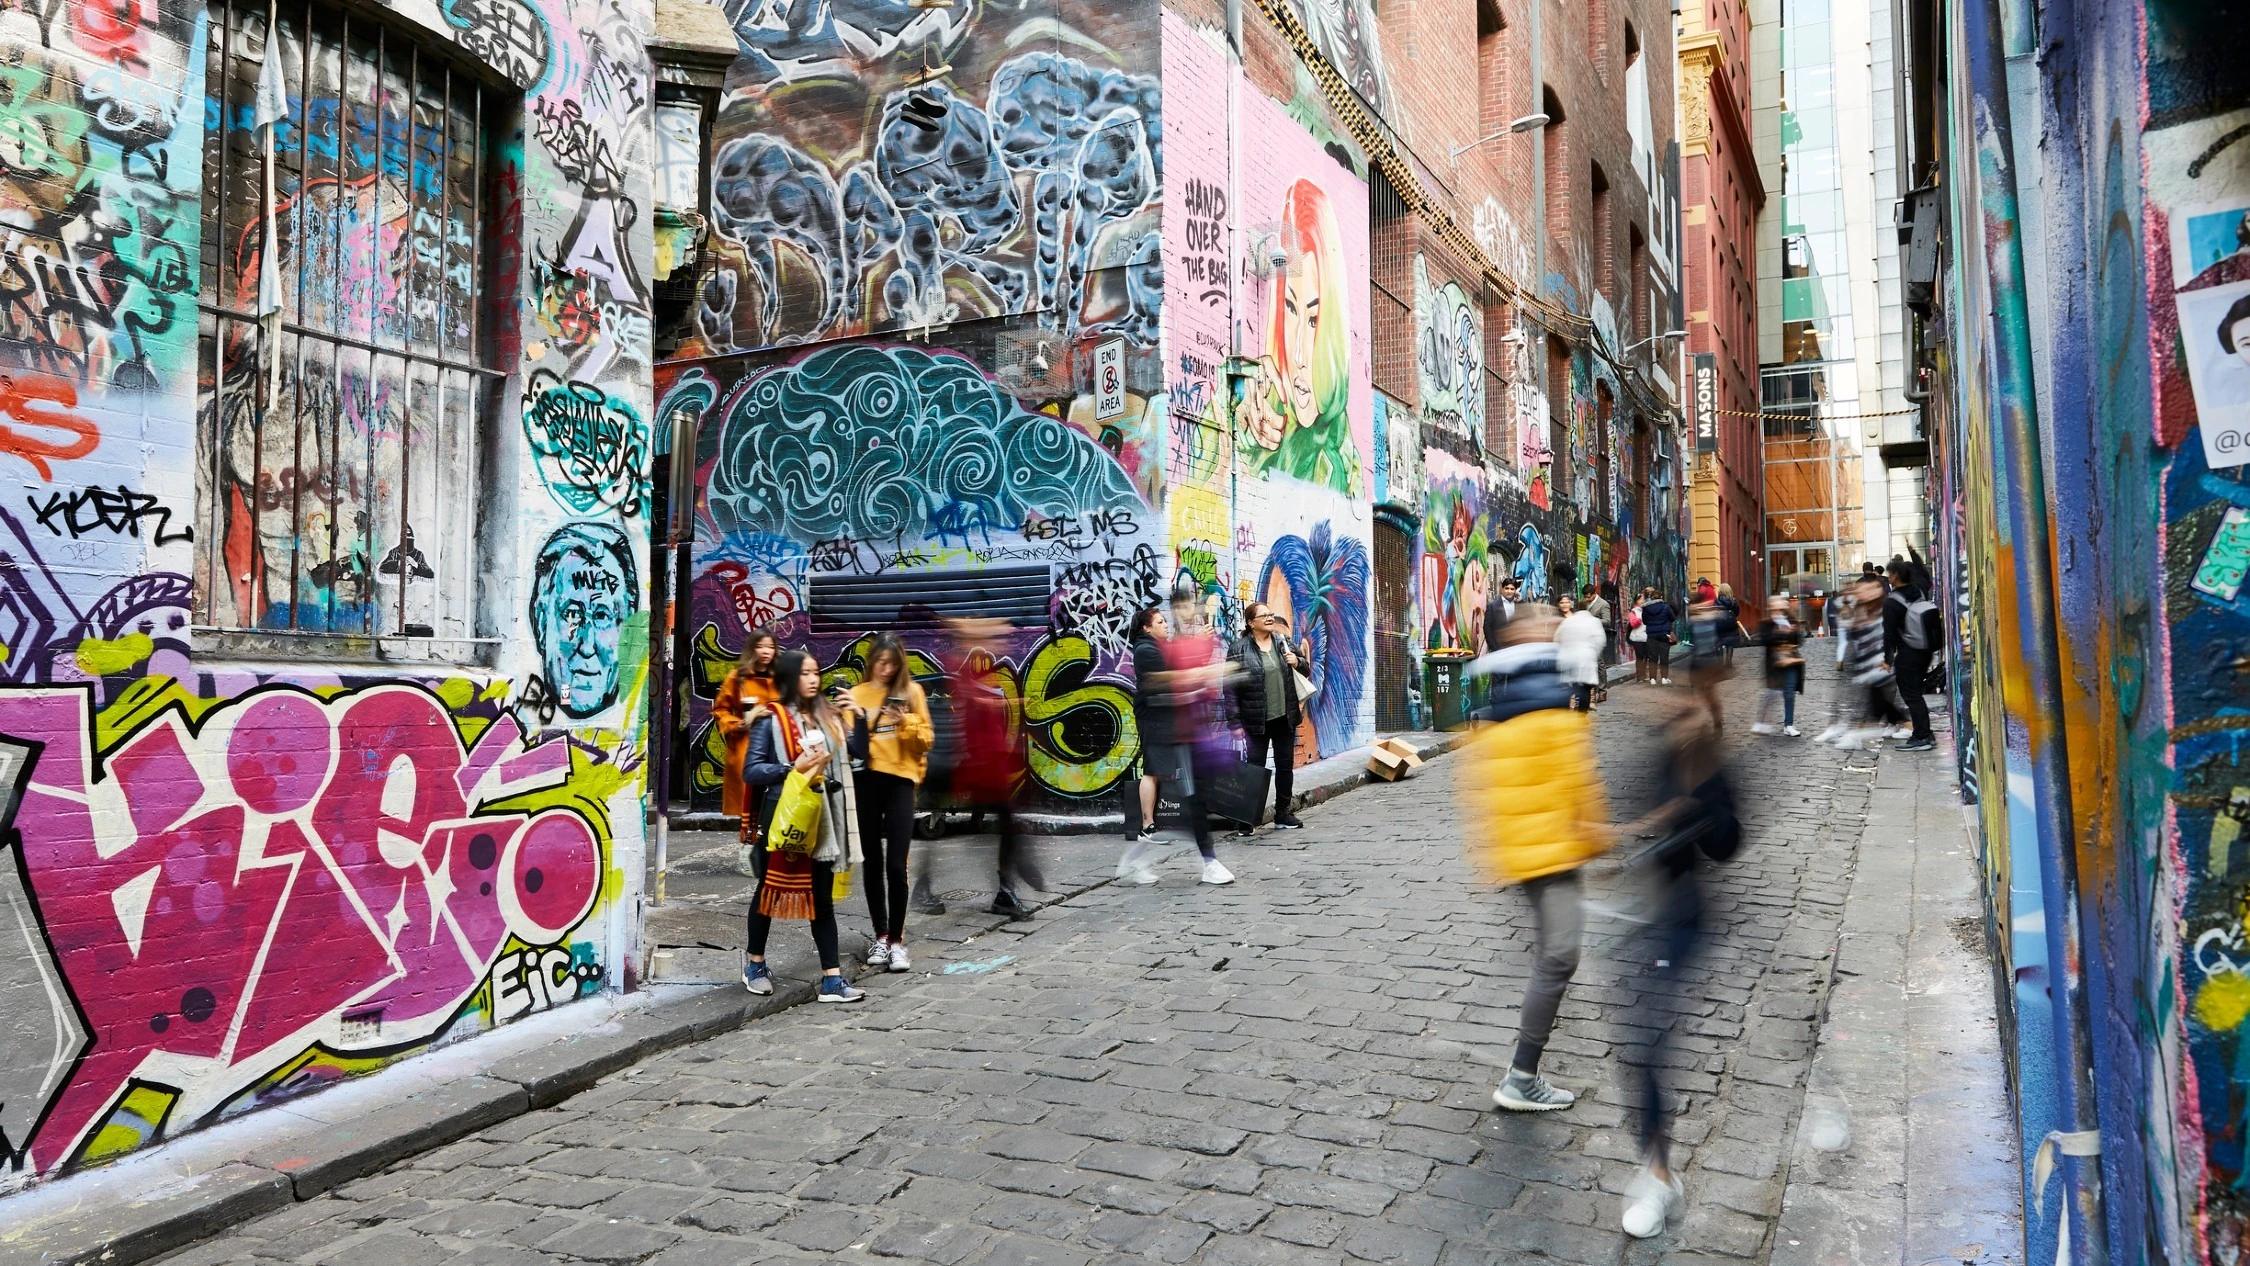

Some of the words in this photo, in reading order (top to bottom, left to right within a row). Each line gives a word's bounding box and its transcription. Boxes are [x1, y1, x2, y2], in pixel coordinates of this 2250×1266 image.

[1185, 177, 1227, 221] HAND
[1186, 218, 1223, 254] OVER
[1181, 255, 1205, 282] THE
[1102, 348, 1117, 364] END
[1100, 396, 1121, 413] AREA
[1697, 366, 1712, 438] MASONS
[781, 824, 809, 844] Jay
